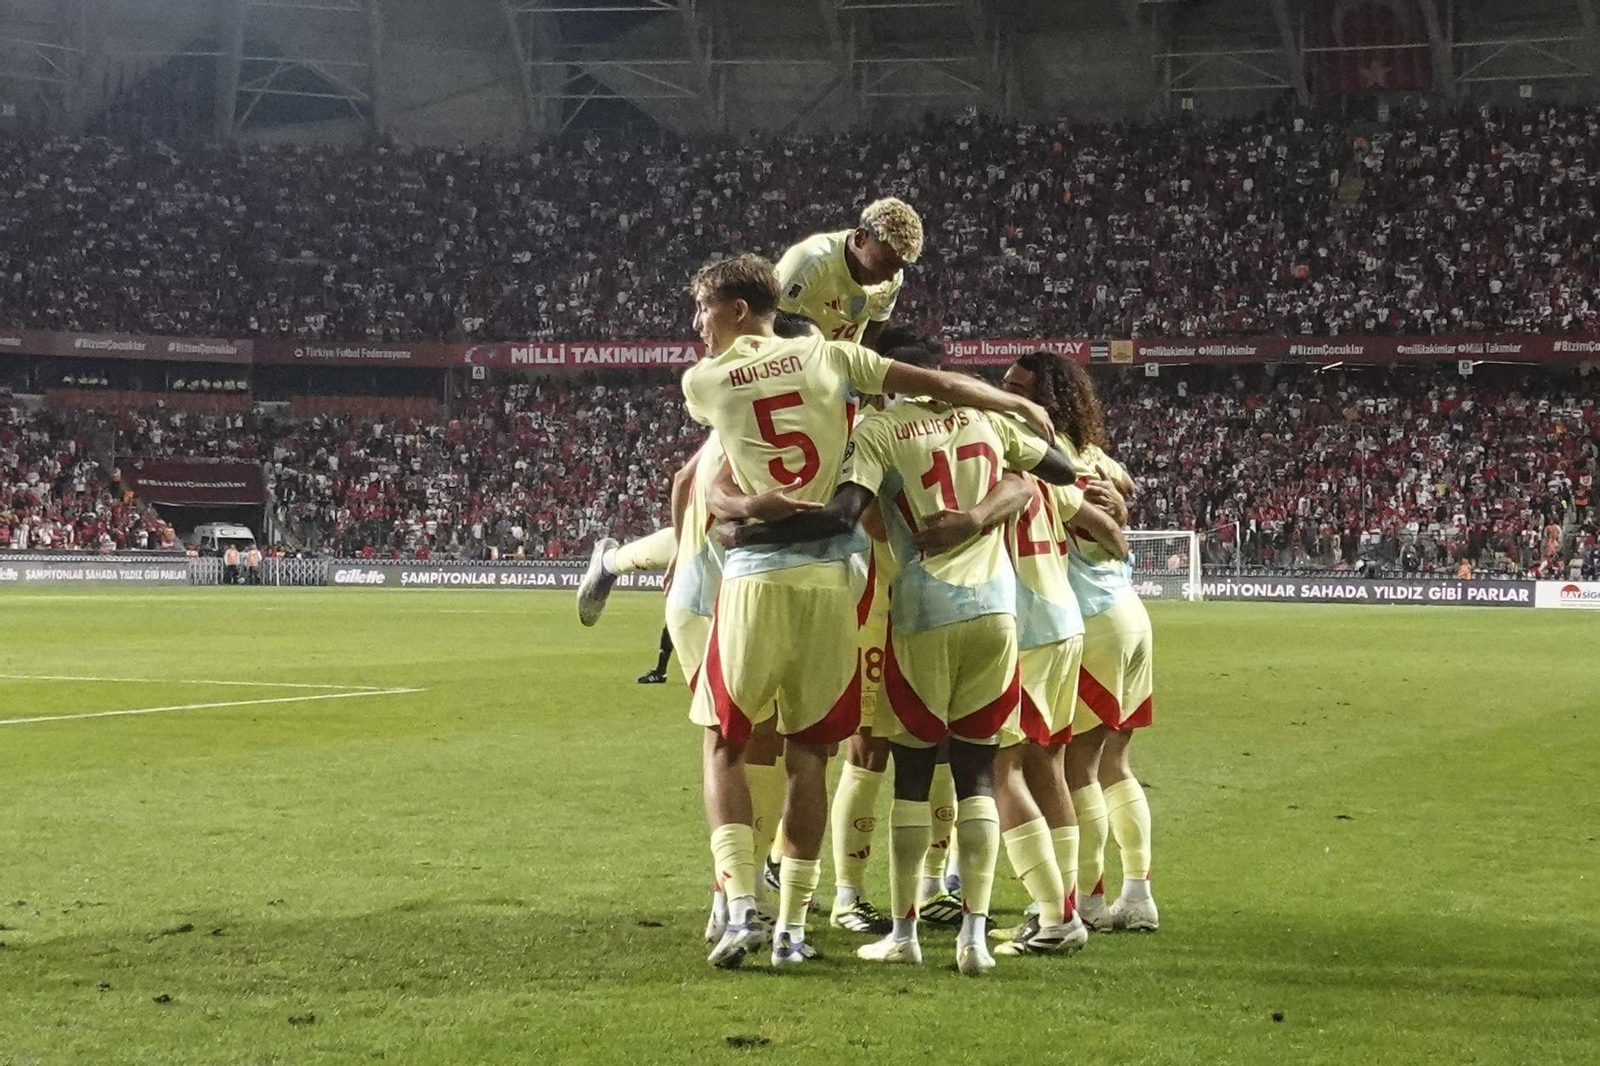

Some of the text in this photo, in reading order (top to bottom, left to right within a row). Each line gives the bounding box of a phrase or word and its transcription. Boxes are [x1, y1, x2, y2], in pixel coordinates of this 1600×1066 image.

[511, 344, 699, 364] MİLLİ TAKIMIMIZA
[981, 341, 1035, 355] İbrahim
[1289, 343, 1364, 357] #BizimÇocuklar
[1553, 341, 1600, 353] #BizimÇo
[728, 355, 803, 387] HUIJSEN
[752, 391, 821, 488] 5
[920, 441, 999, 512] 17
[85, 570, 118, 580] SAHADA
[119, 570, 143, 580] YILDIZ
[161, 570, 187, 580] PARLAR
[334, 569, 386, 584] Gillette
[401, 568, 496, 586] ŞAMPİYONLAR
[500, 573, 557, 586] SAHADA
[1300, 584, 1369, 599] SAHADA
[1373, 586, 1424, 600] YILDIZ
[1428, 582, 1462, 600] GİBİ
[1467, 587, 1530, 602] PARLAR
[864, 646, 885, 684] 8
